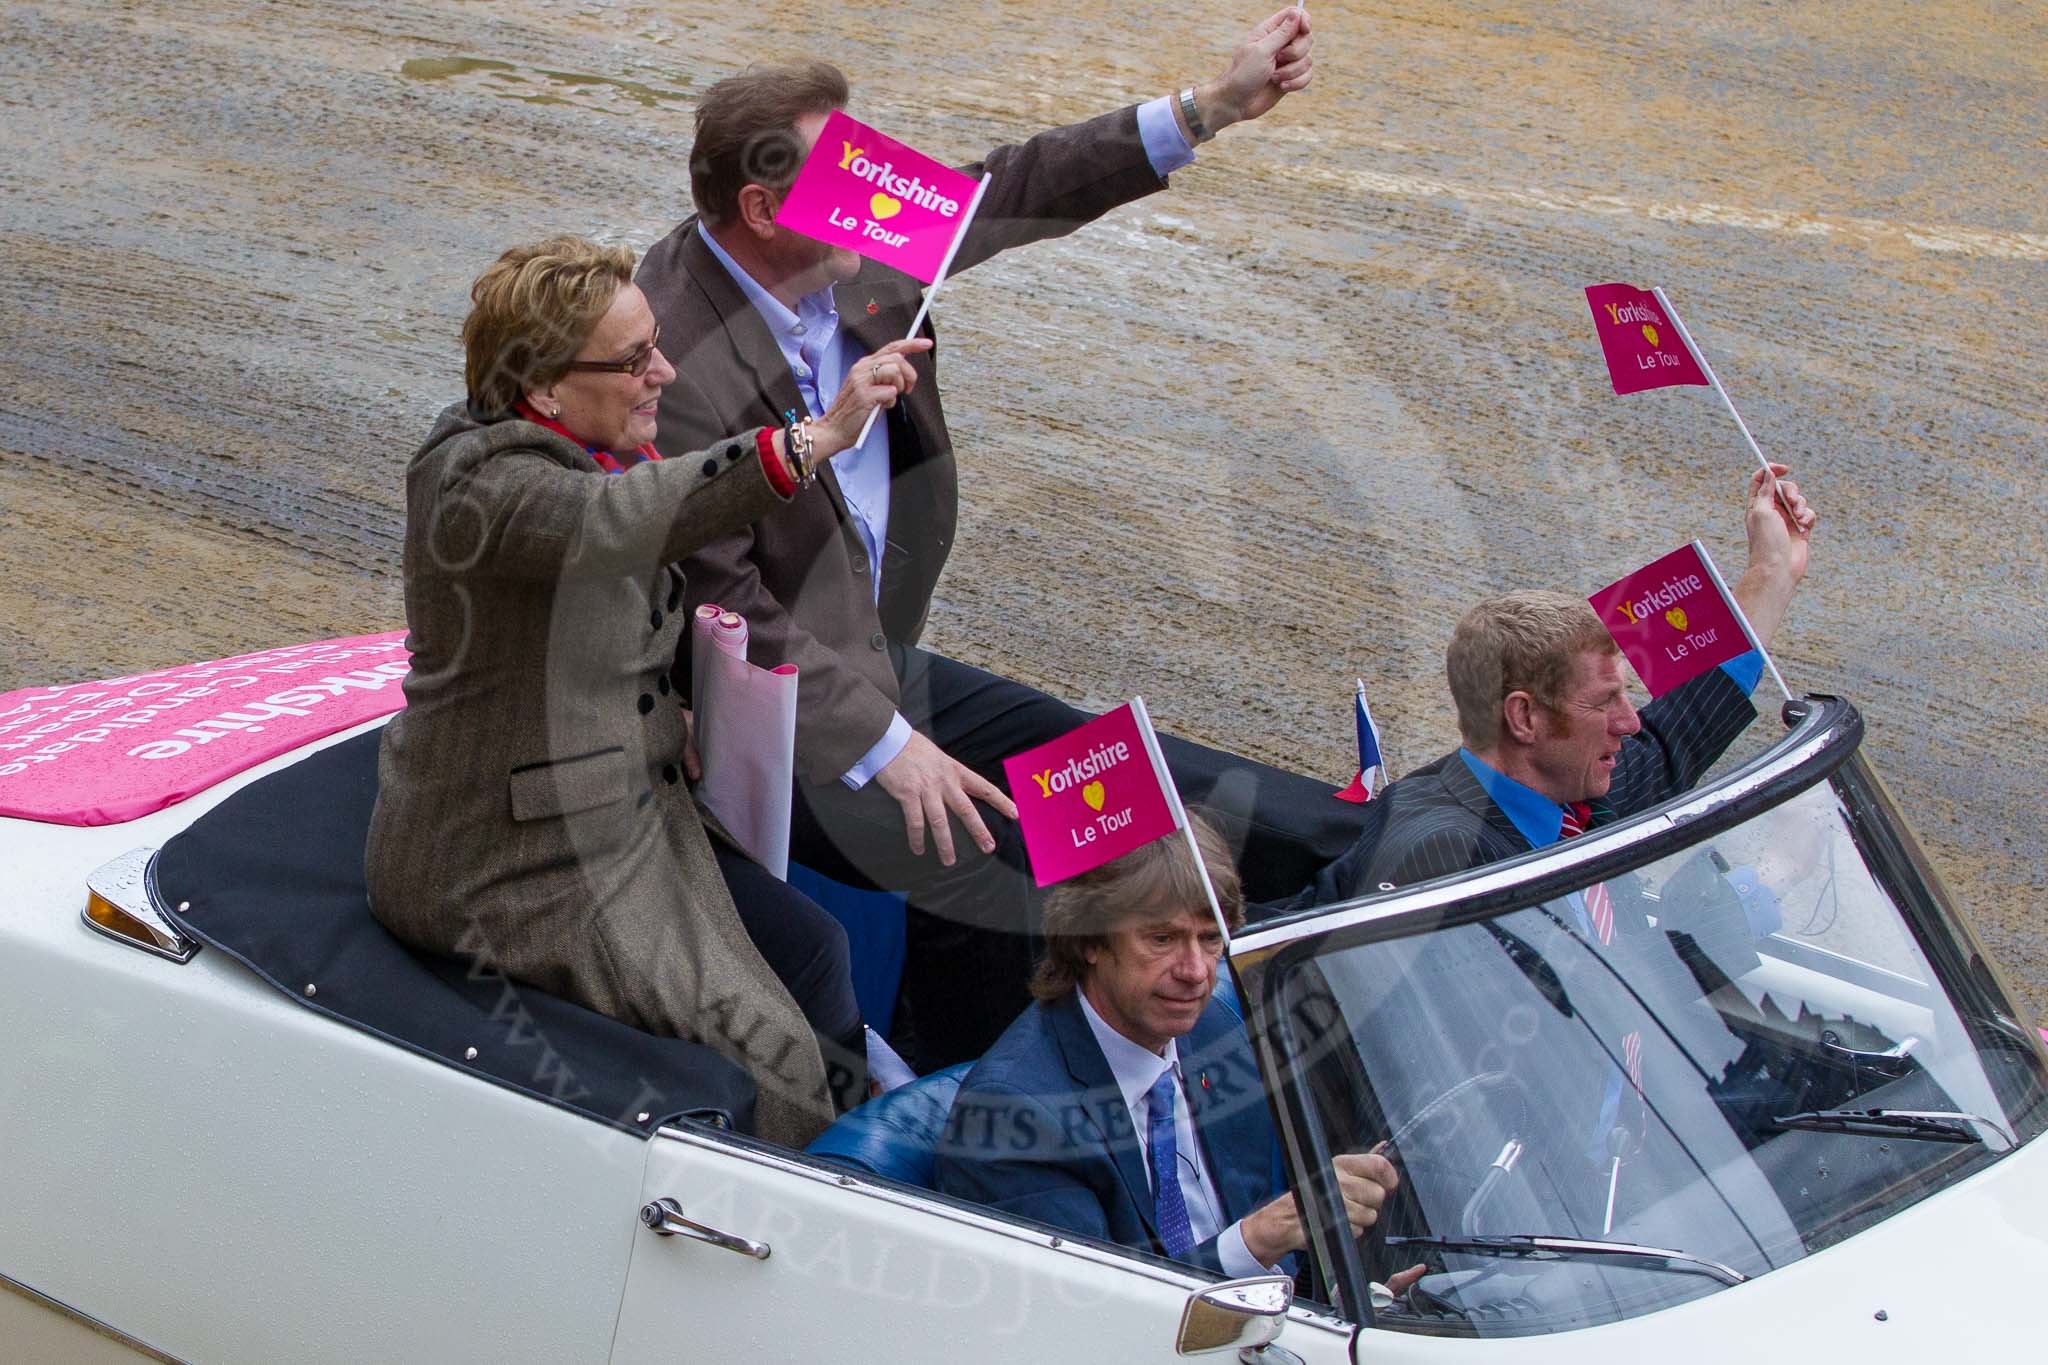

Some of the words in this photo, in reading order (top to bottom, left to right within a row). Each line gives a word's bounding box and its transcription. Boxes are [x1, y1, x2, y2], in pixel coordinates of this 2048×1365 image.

[838, 141, 959, 217] Yorkshire
[828, 207, 858, 231] Le
[862, 219, 911, 248] Tour
[1637, 353, 1656, 370] Le
[1616, 574, 1703, 625] Yorkshire
[174, 644, 339, 678] Grand
[258, 637, 406, 674] fficial
[1665, 644, 1689, 662] Le
[1684, 627, 1719, 652] Tour
[0, 676, 259, 776] Candidate
[126, 660, 411, 759] orkshire
[1032, 741, 1130, 798] Yorkshire
[1071, 826, 1097, 848] Le
[1096, 807, 1133, 836] Tour
